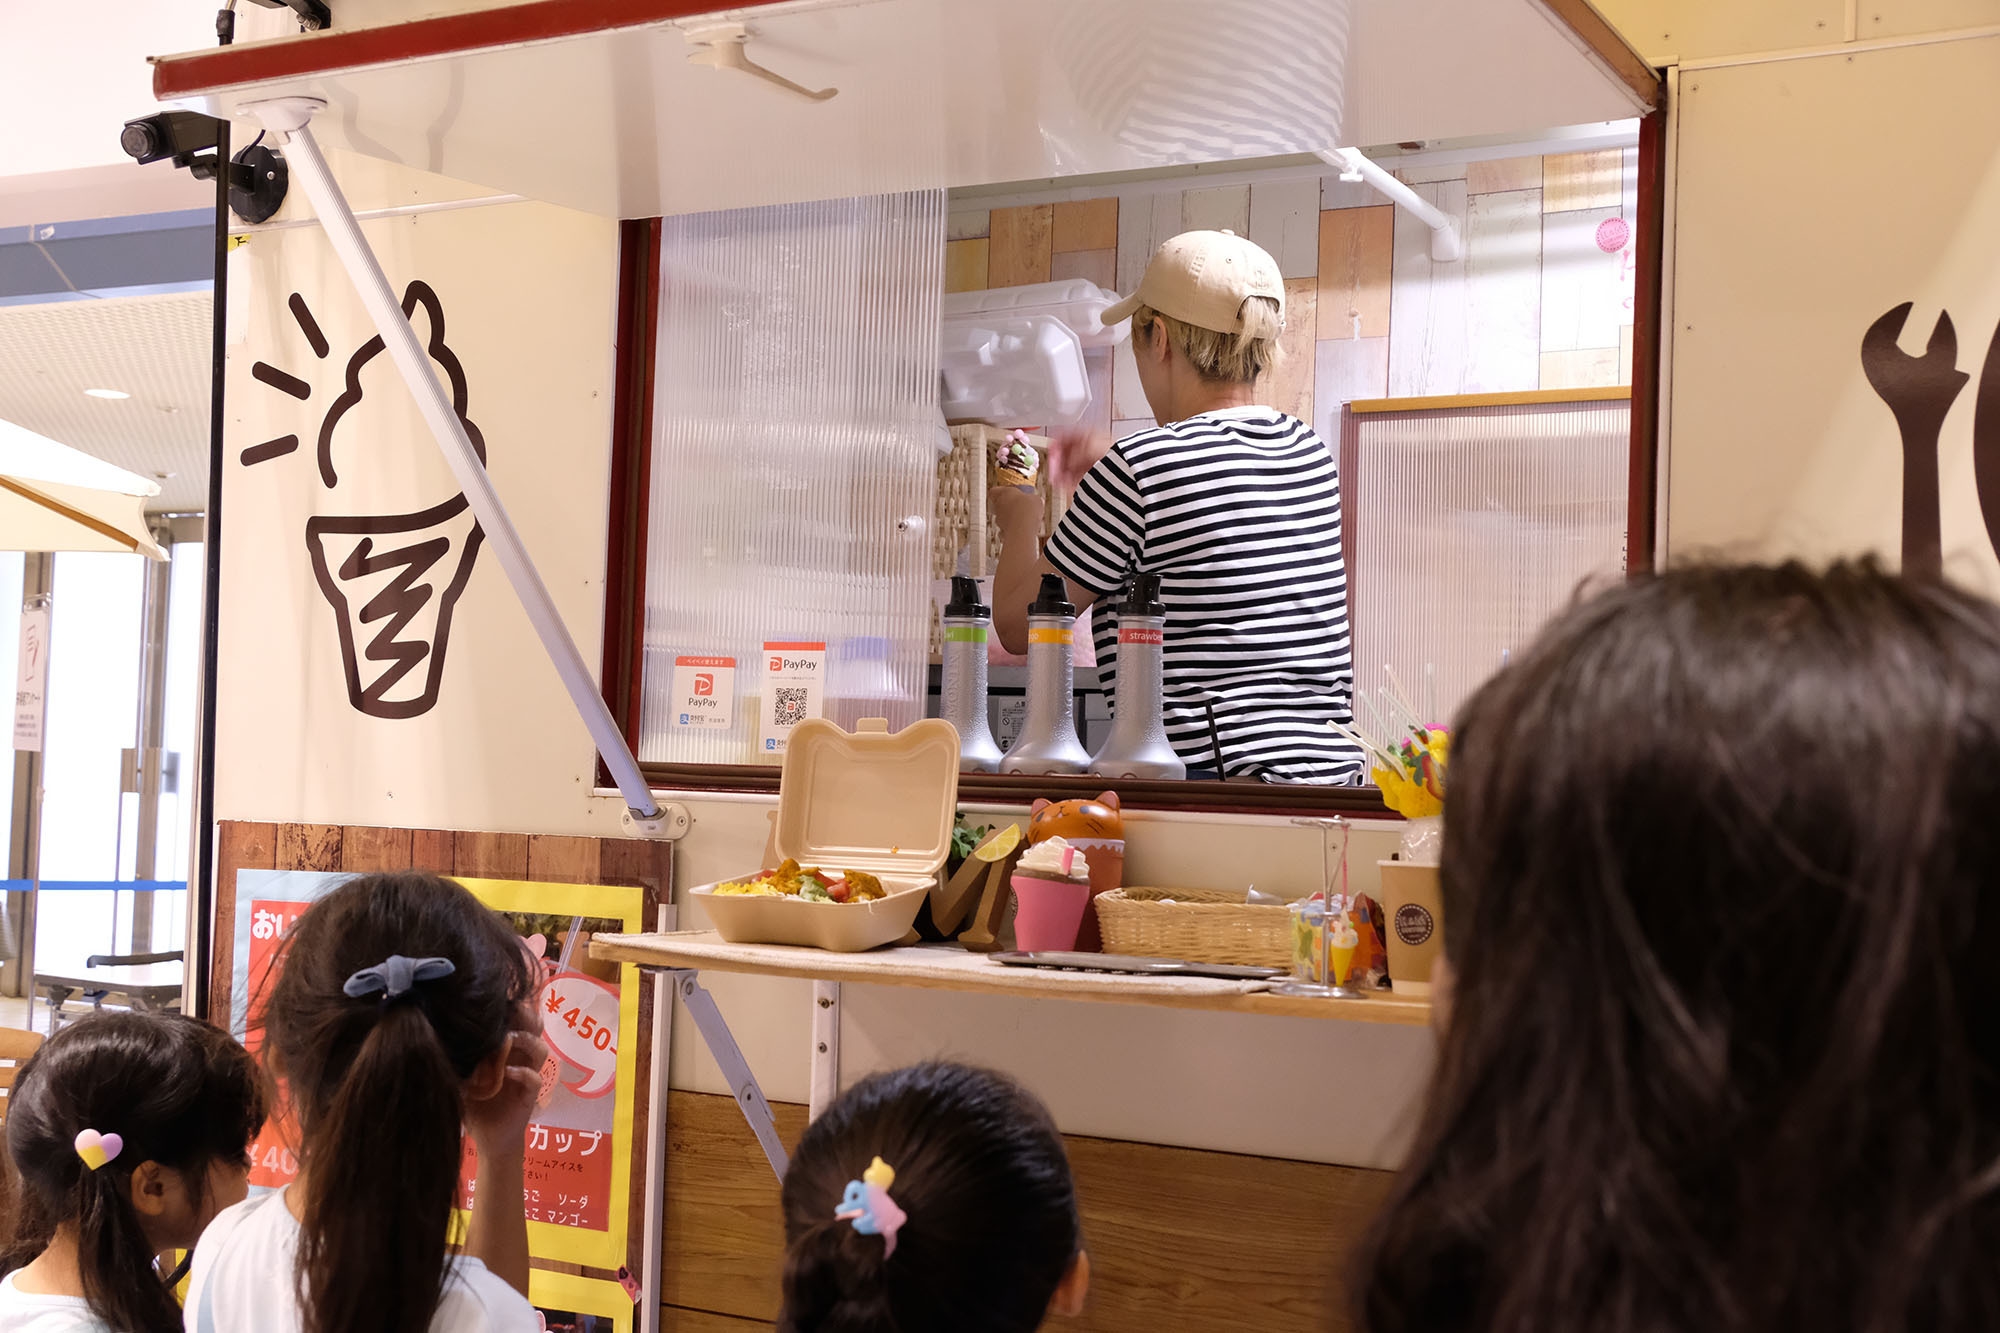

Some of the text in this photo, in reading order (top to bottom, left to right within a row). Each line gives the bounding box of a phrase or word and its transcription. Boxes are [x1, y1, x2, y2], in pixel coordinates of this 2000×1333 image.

[783, 658, 817, 671] PayPay
[688, 697, 718, 709] PayPay
[252, 909, 299, 941] おい
[529, 1123, 603, 1157] カップ
[246, 1144, 299, 1176] ¥40
[523, 1157, 584, 1173] リームアイスを
[523, 1170, 549, 1181] さい！
[558, 1193, 589, 1209] ソーダ
[548, 1210, 588, 1227] マンゴー
